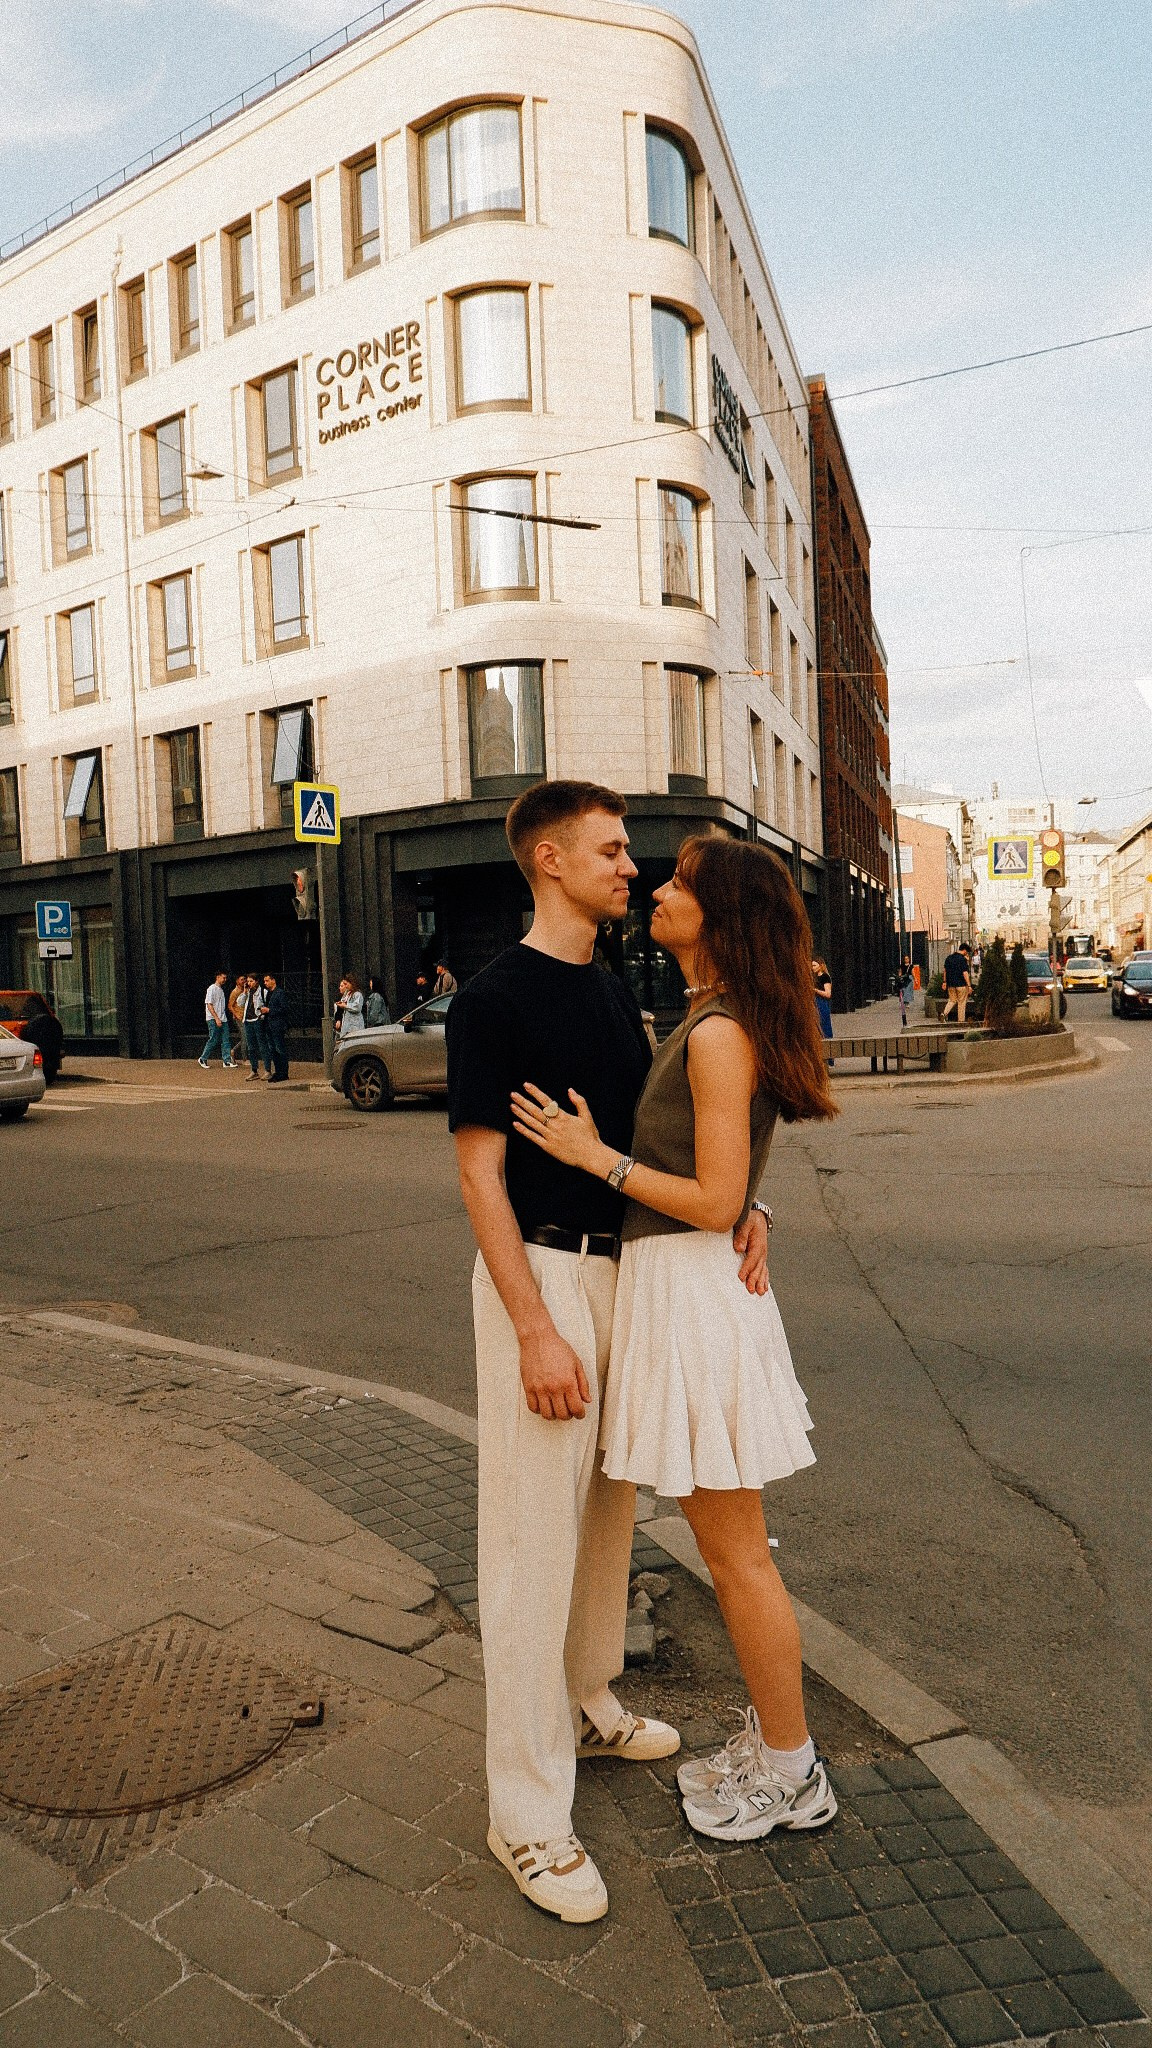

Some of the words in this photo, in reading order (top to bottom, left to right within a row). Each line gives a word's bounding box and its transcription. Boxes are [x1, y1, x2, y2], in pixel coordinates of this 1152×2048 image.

[316, 320, 421, 386] CORNER
[316, 352, 423, 420] PLACE
[318, 414, 371, 444] business
[376, 393, 423, 422] center
[43, 905, 64, 935] P
[747, 1789, 775, 1812] N
